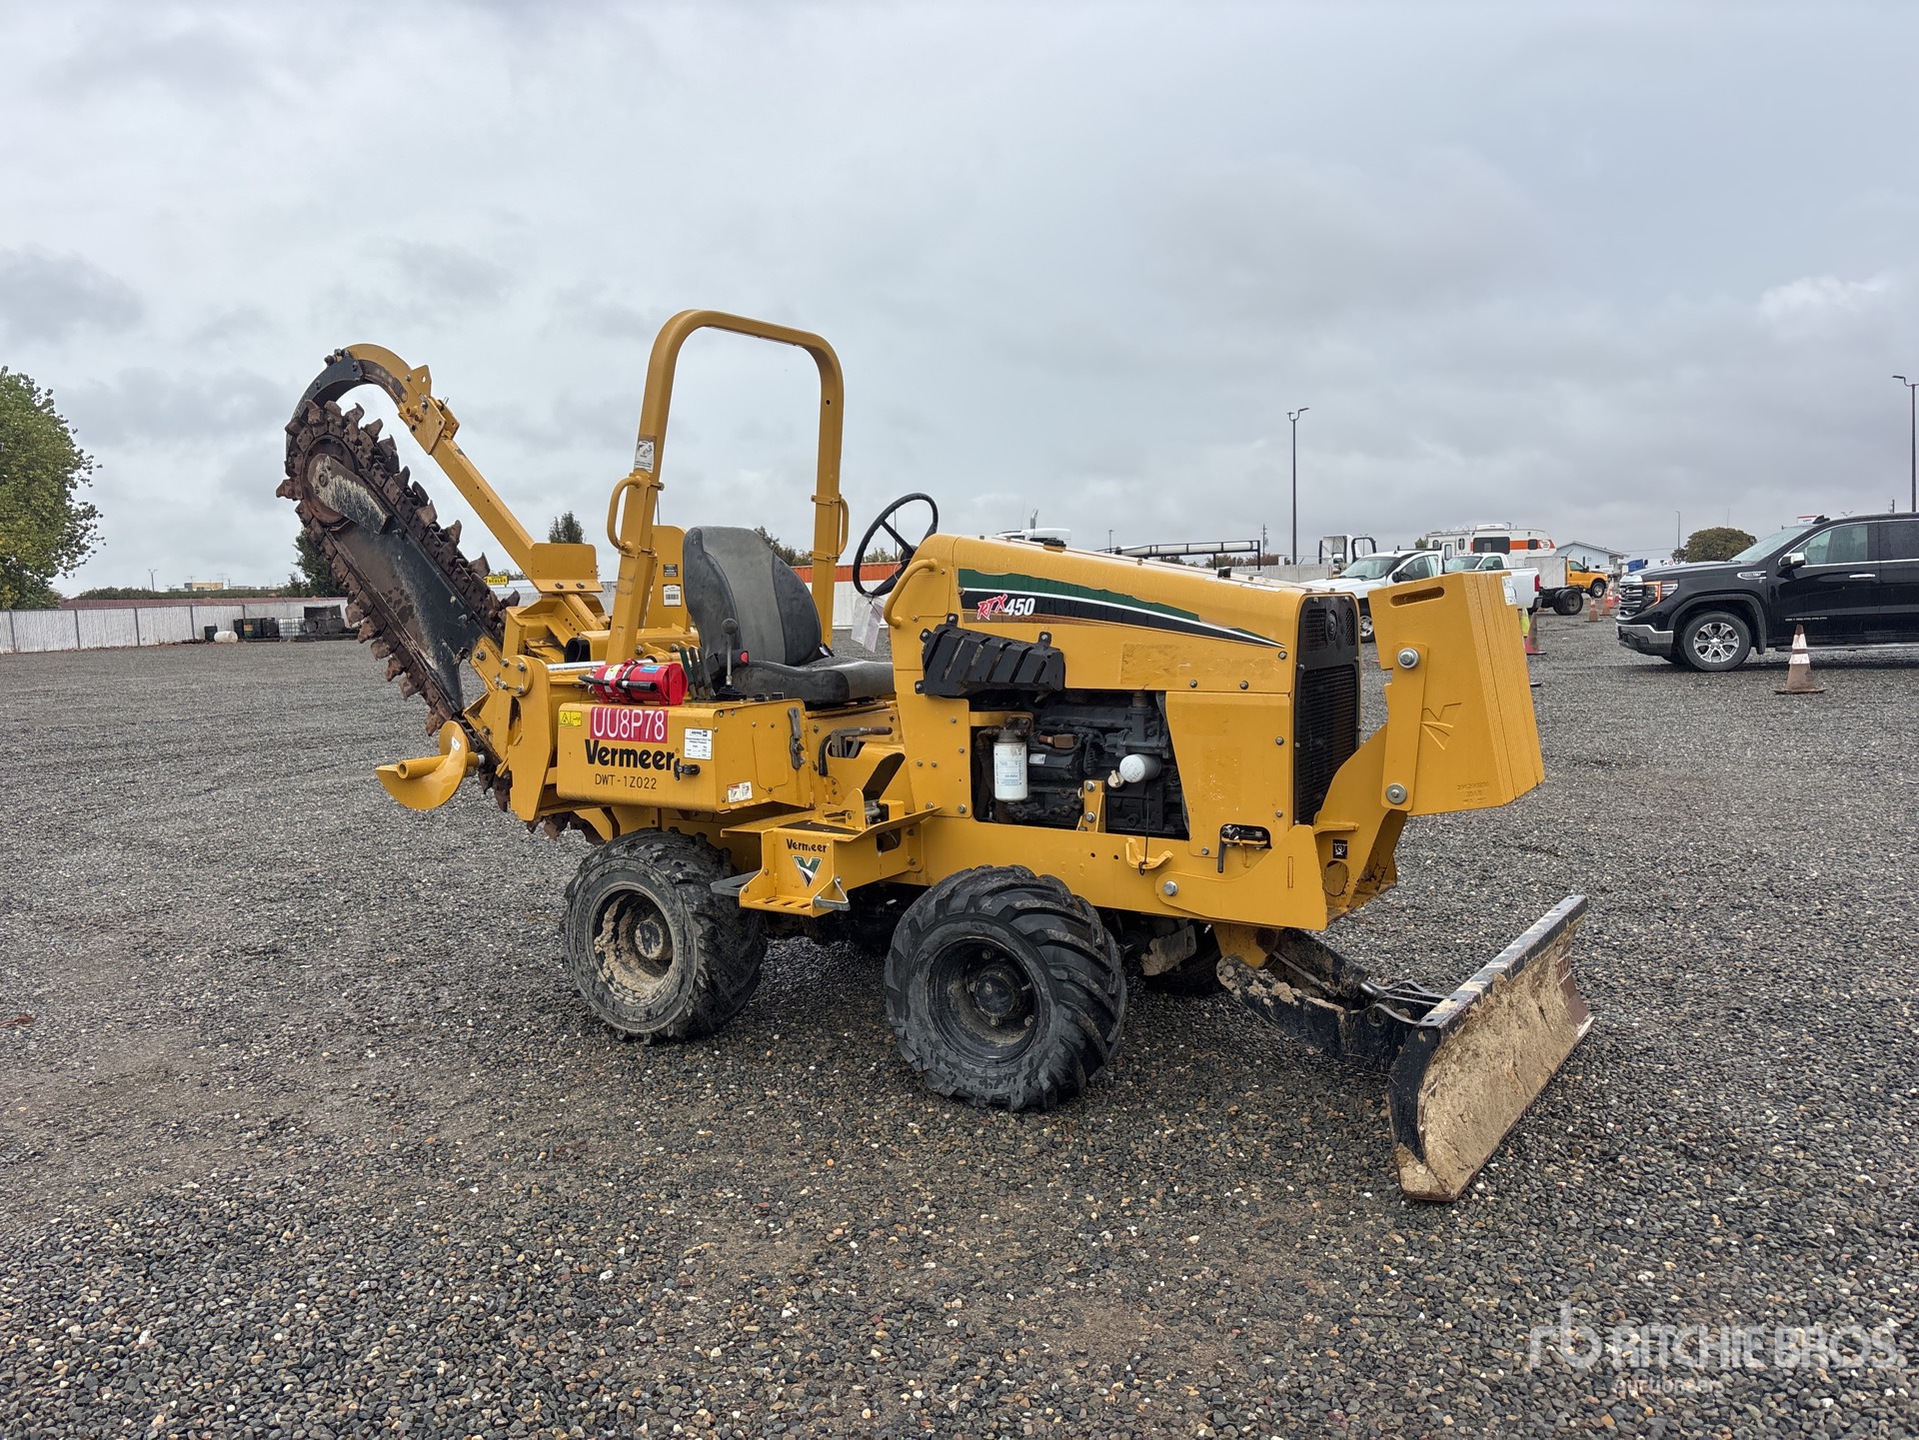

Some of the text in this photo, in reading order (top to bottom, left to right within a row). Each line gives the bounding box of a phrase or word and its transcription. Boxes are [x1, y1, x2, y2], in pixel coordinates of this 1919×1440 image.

[593, 707, 665, 740] UU8P78
[584, 738, 675, 771] Vermeer
[786, 838, 827, 853] Vermeer
